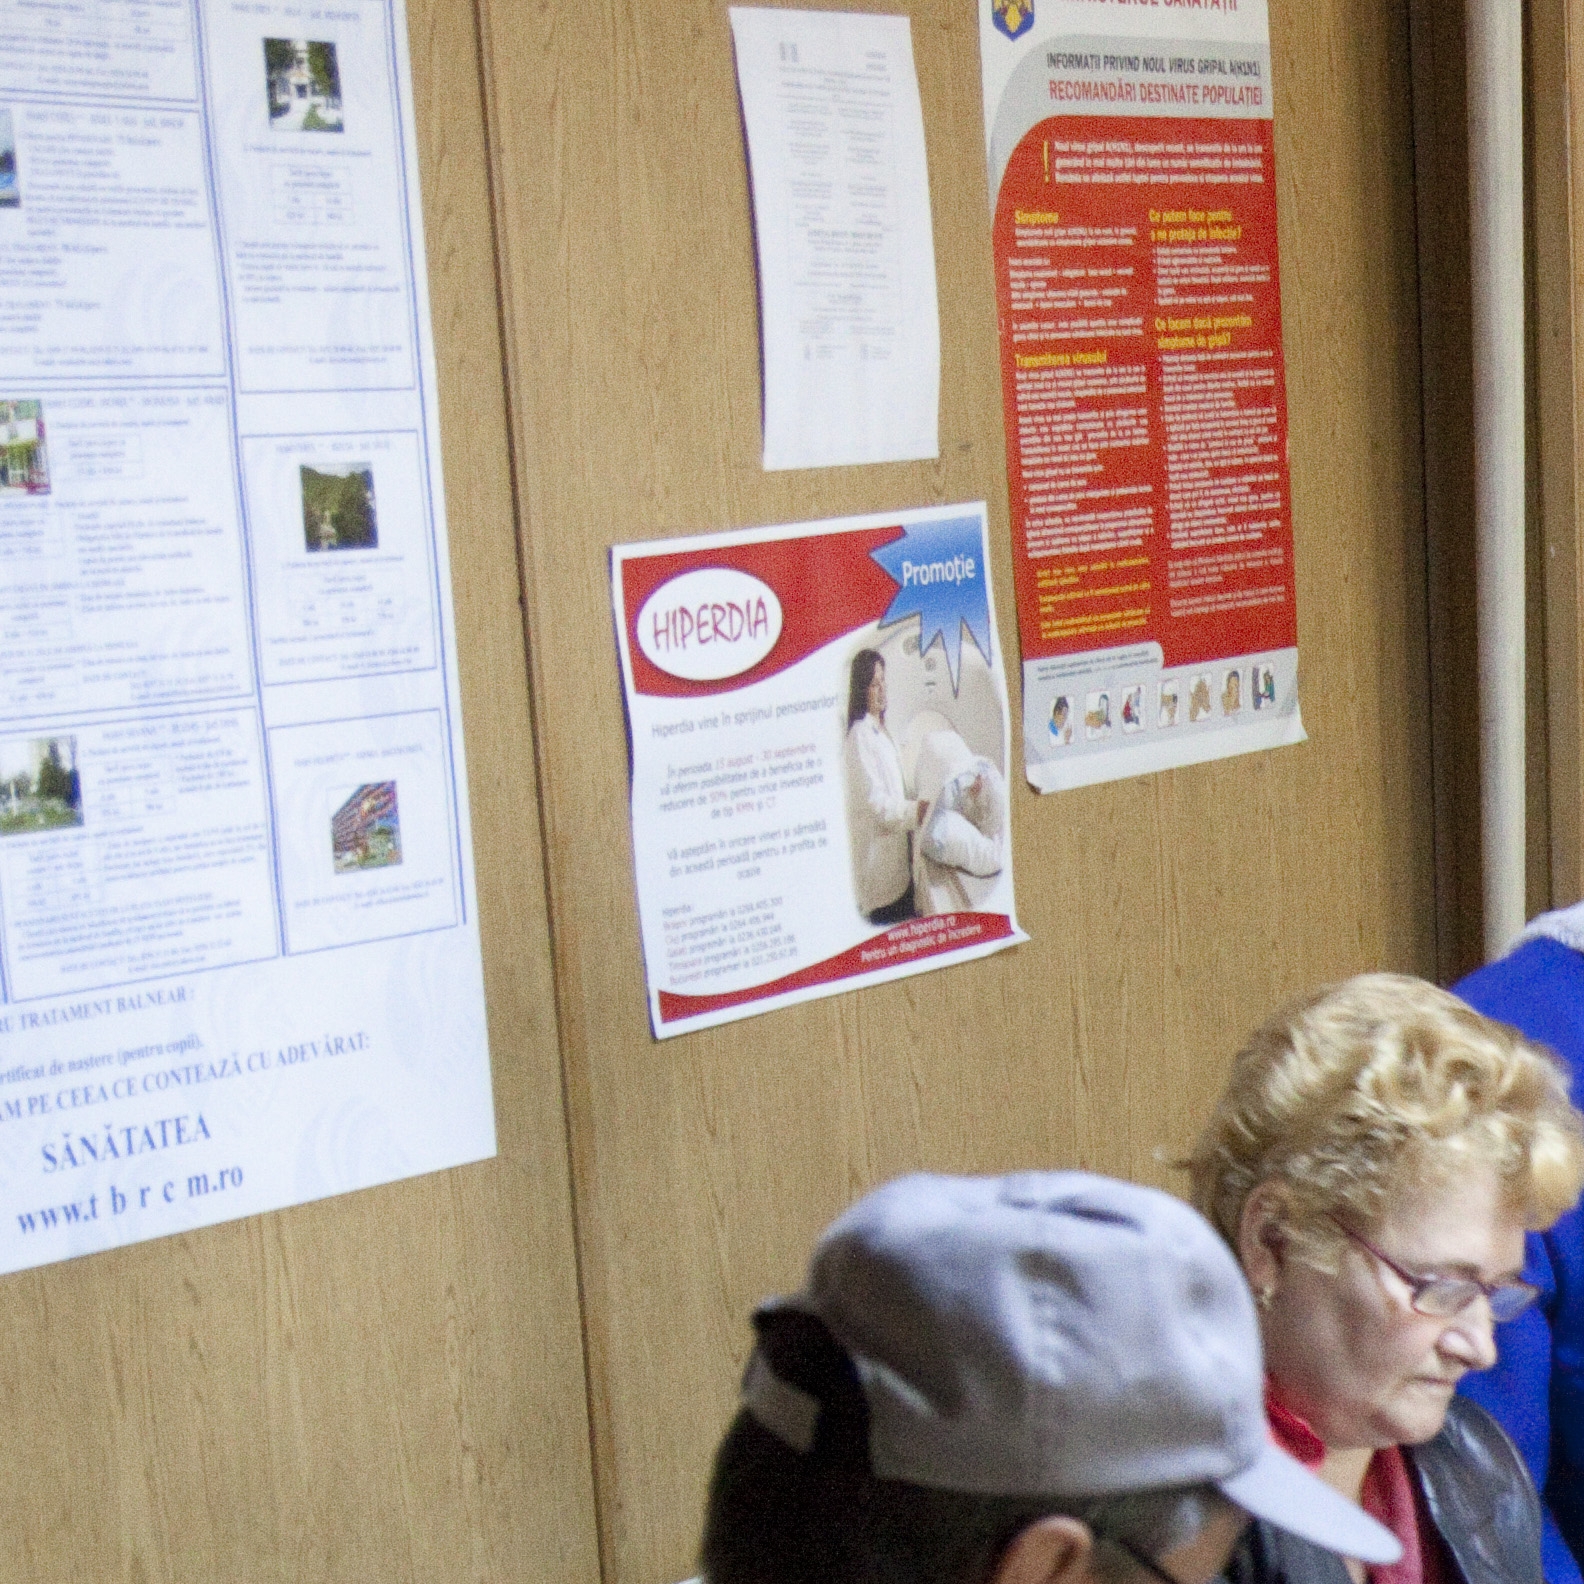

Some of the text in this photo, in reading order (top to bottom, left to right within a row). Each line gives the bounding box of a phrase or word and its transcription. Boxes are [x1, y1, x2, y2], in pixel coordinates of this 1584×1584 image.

[1104, 54, 1140, 71] PRIVIND
[1142, 56, 1166, 73] NOUL
[1170, 57, 1195, 73] VIRUS
[1198, 58, 1227, 75] GRIPAL
[1049, 78, 1136, 102] RECOMANDĂRI
[1140, 81, 1199, 104] DESTINATE
[902, 553, 977, 588] Promoție
[653, 595, 769, 652] HIPERDIA
[652, 720, 694, 739] Hiperdia
[698, 716, 718, 731] vine
[734, 704, 773, 727] sprijinul
[727, 754, 754, 769] august
[774, 743, 816, 759] septembrie
[749, 769, 759, 780] de
[805, 758, 815, 769] de
[659, 798, 695, 812] reducere
[697, 795, 707, 806] de
[730, 786, 756, 801] pentru
[758, 828, 782, 842] vineri
[752, 846, 779, 862] pentru
[20, 998, 112, 1030] TRATAMENT
[117, 985, 187, 1013] BALNEAR
[27, 1094, 51, 1115] PE
[56, 1085, 109, 1111] CEEA
[112, 1077, 138, 1099] CE
[142, 1050, 242, 1092] CONTEAZĂ
[247, 1051, 272, 1072] CU
[277, 1031, 369, 1067] ADEVĂRAT:
[49, 1058, 63, 1075] de
[117, 1044, 163, 1066] (pentru
[41, 1112, 211, 1173] SĂNĂTATEA
